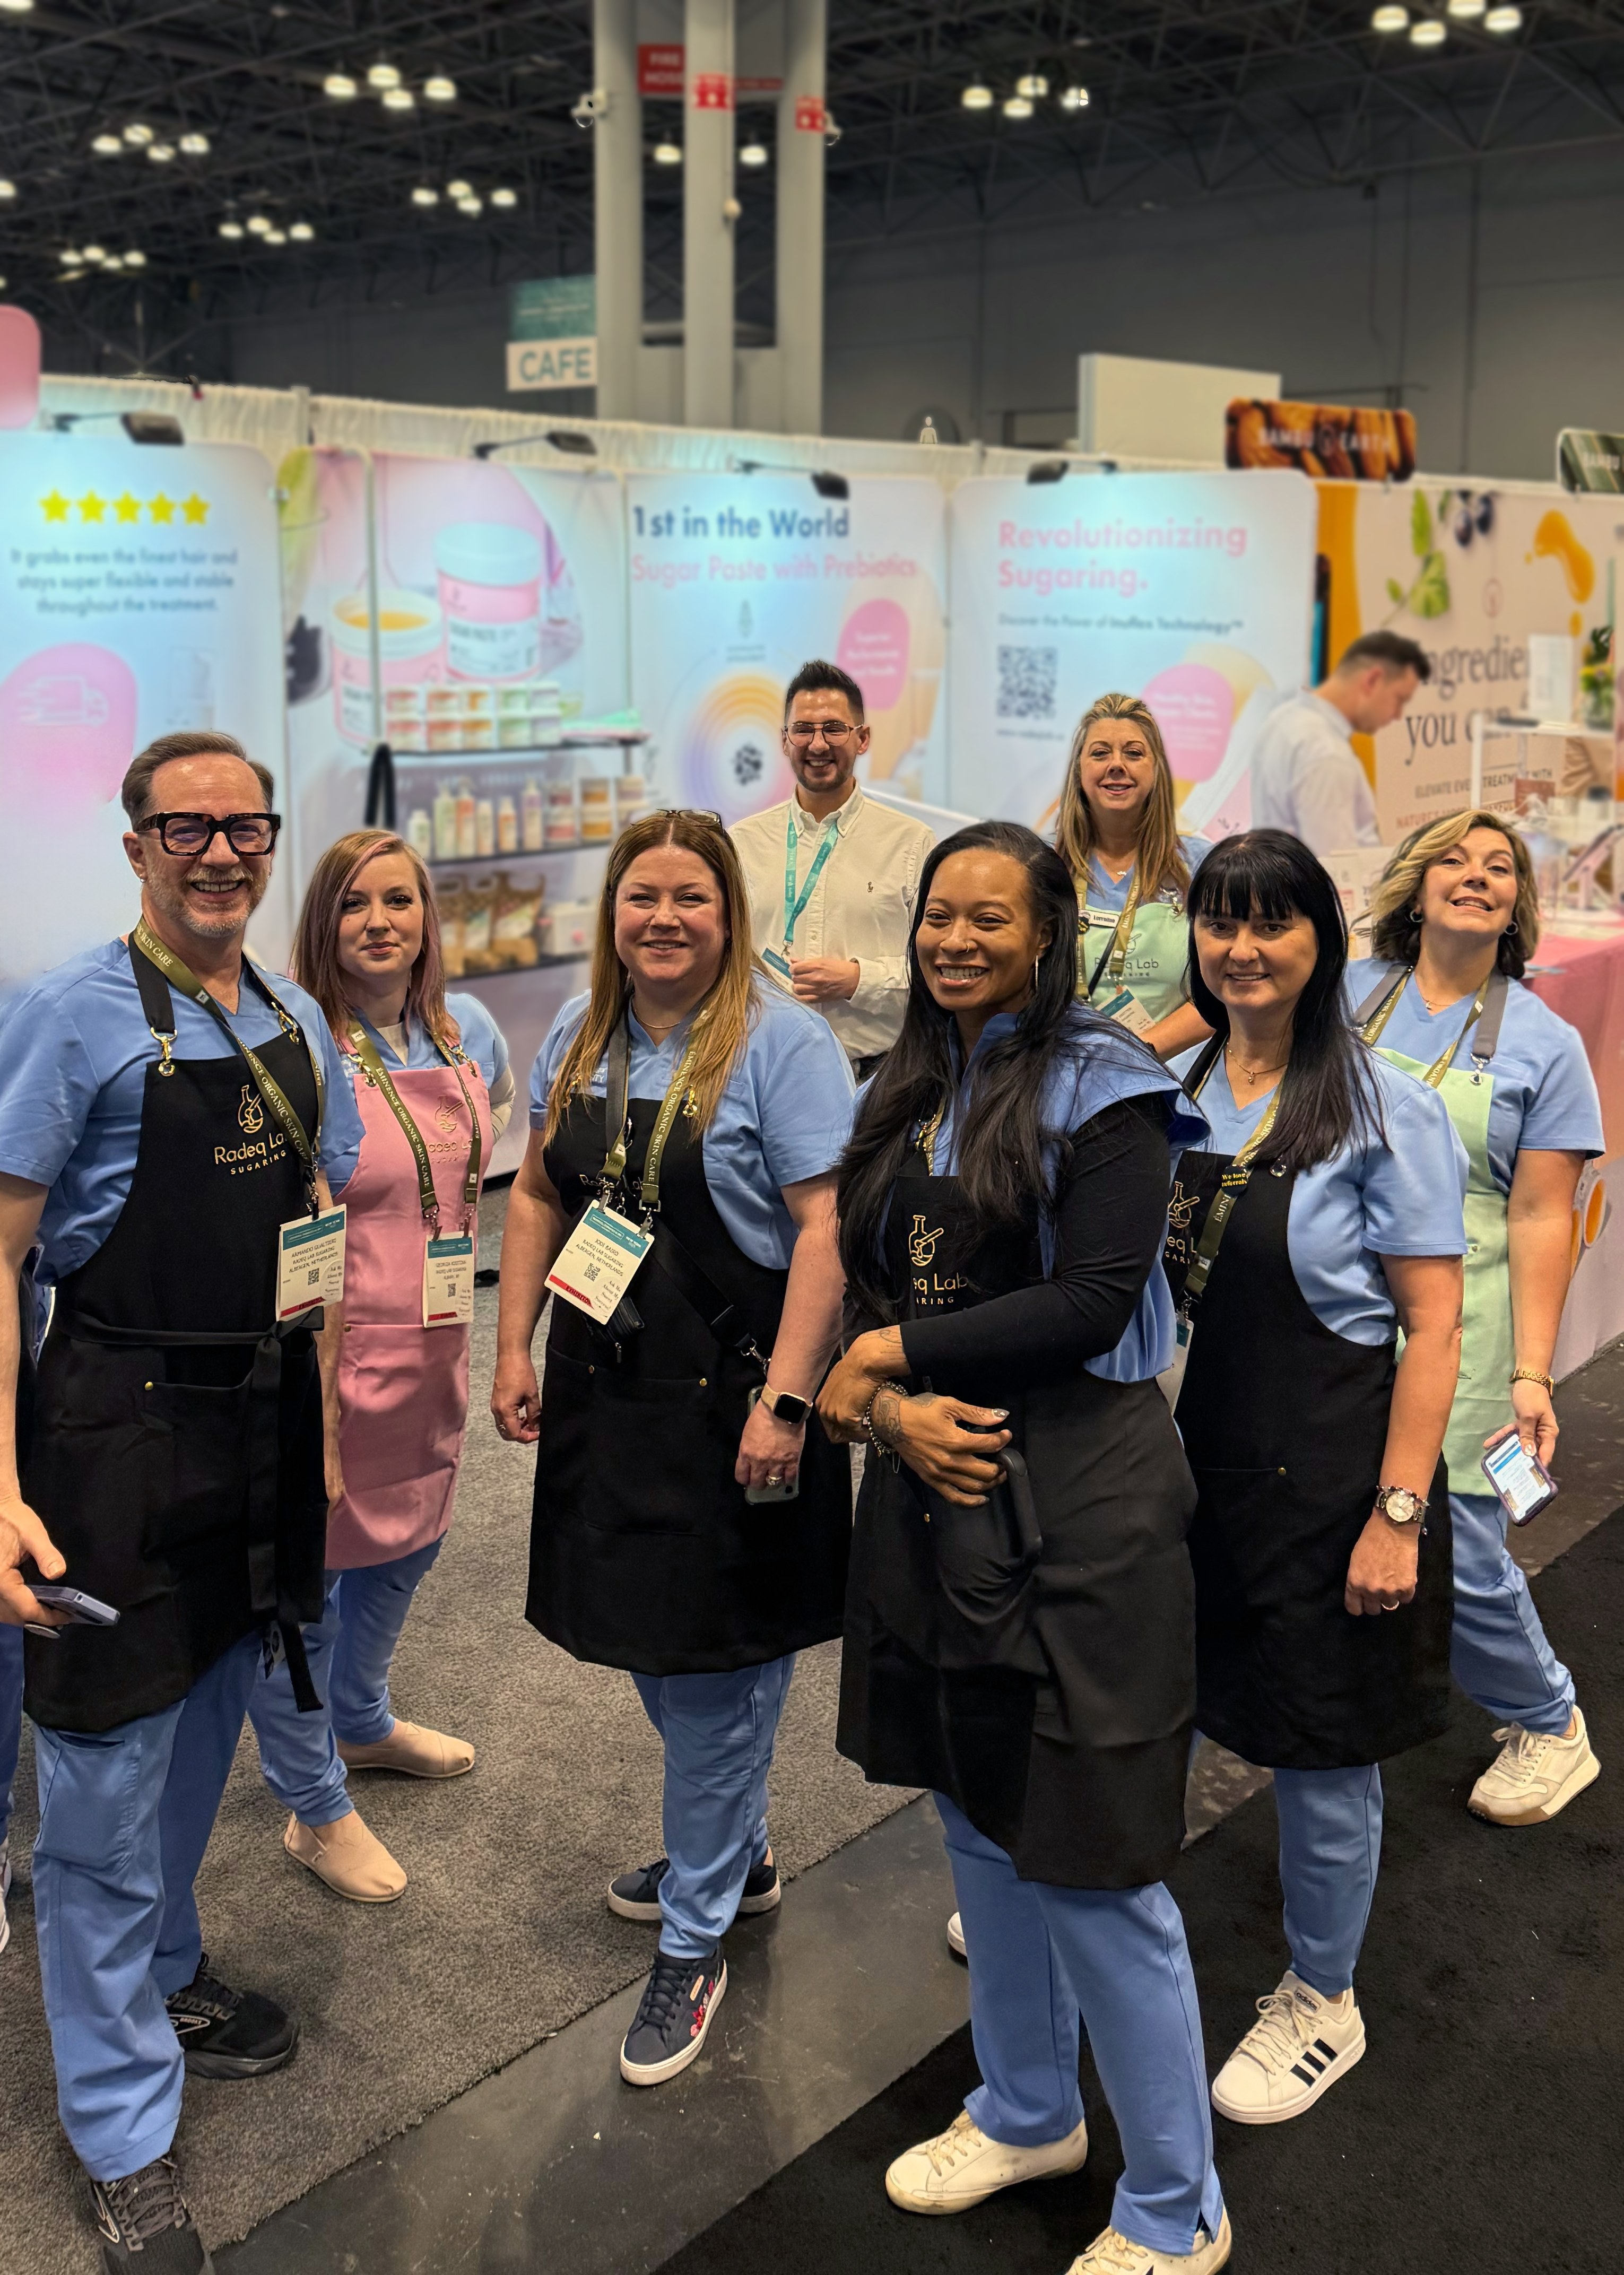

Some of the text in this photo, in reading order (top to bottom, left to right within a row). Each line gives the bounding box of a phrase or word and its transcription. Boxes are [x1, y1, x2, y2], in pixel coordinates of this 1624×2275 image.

[649, 53, 680, 66] FIRE
[518, 347, 592, 383] CAFE
[1258, 428, 1391, 451] BAMBU EARTH
[633, 506, 850, 539] 1st in the World
[998, 518, 1247, 557] Revolutionizing
[75, 551, 109, 565] even
[114, 549, 136, 564] the
[213, 549, 238, 564] and
[632, 553, 917, 589] Sugar Paste with Prebiotics
[61, 576, 101, 592] super
[163, 573, 189, 589] and
[998, 560, 1148, 597] Sugaring.
[124, 597, 144, 612] the
[1406, 714, 1456, 766] you
[141, 932, 173, 967] SKIN CARE
[1137, 957, 1159, 969] Lab
[262, 1076, 289, 1117] ORGANIC
[284, 1117, 300, 1139] SKIN
[658, 1093, 678, 1133] ORGANIC
[376, 1067, 430, 1188] ÉMINENCE ORGANIC SKIN CARE
[214, 1132, 287, 1165] Radeq La
[652, 1133, 663, 1156] SKIN
[230, 1150, 286, 1175] SUGARING
[648, 1158, 657, 1182] CARE
[934, 1272, 968, 1291] Lab
[1296, 1992, 1317, 2011] adidas
